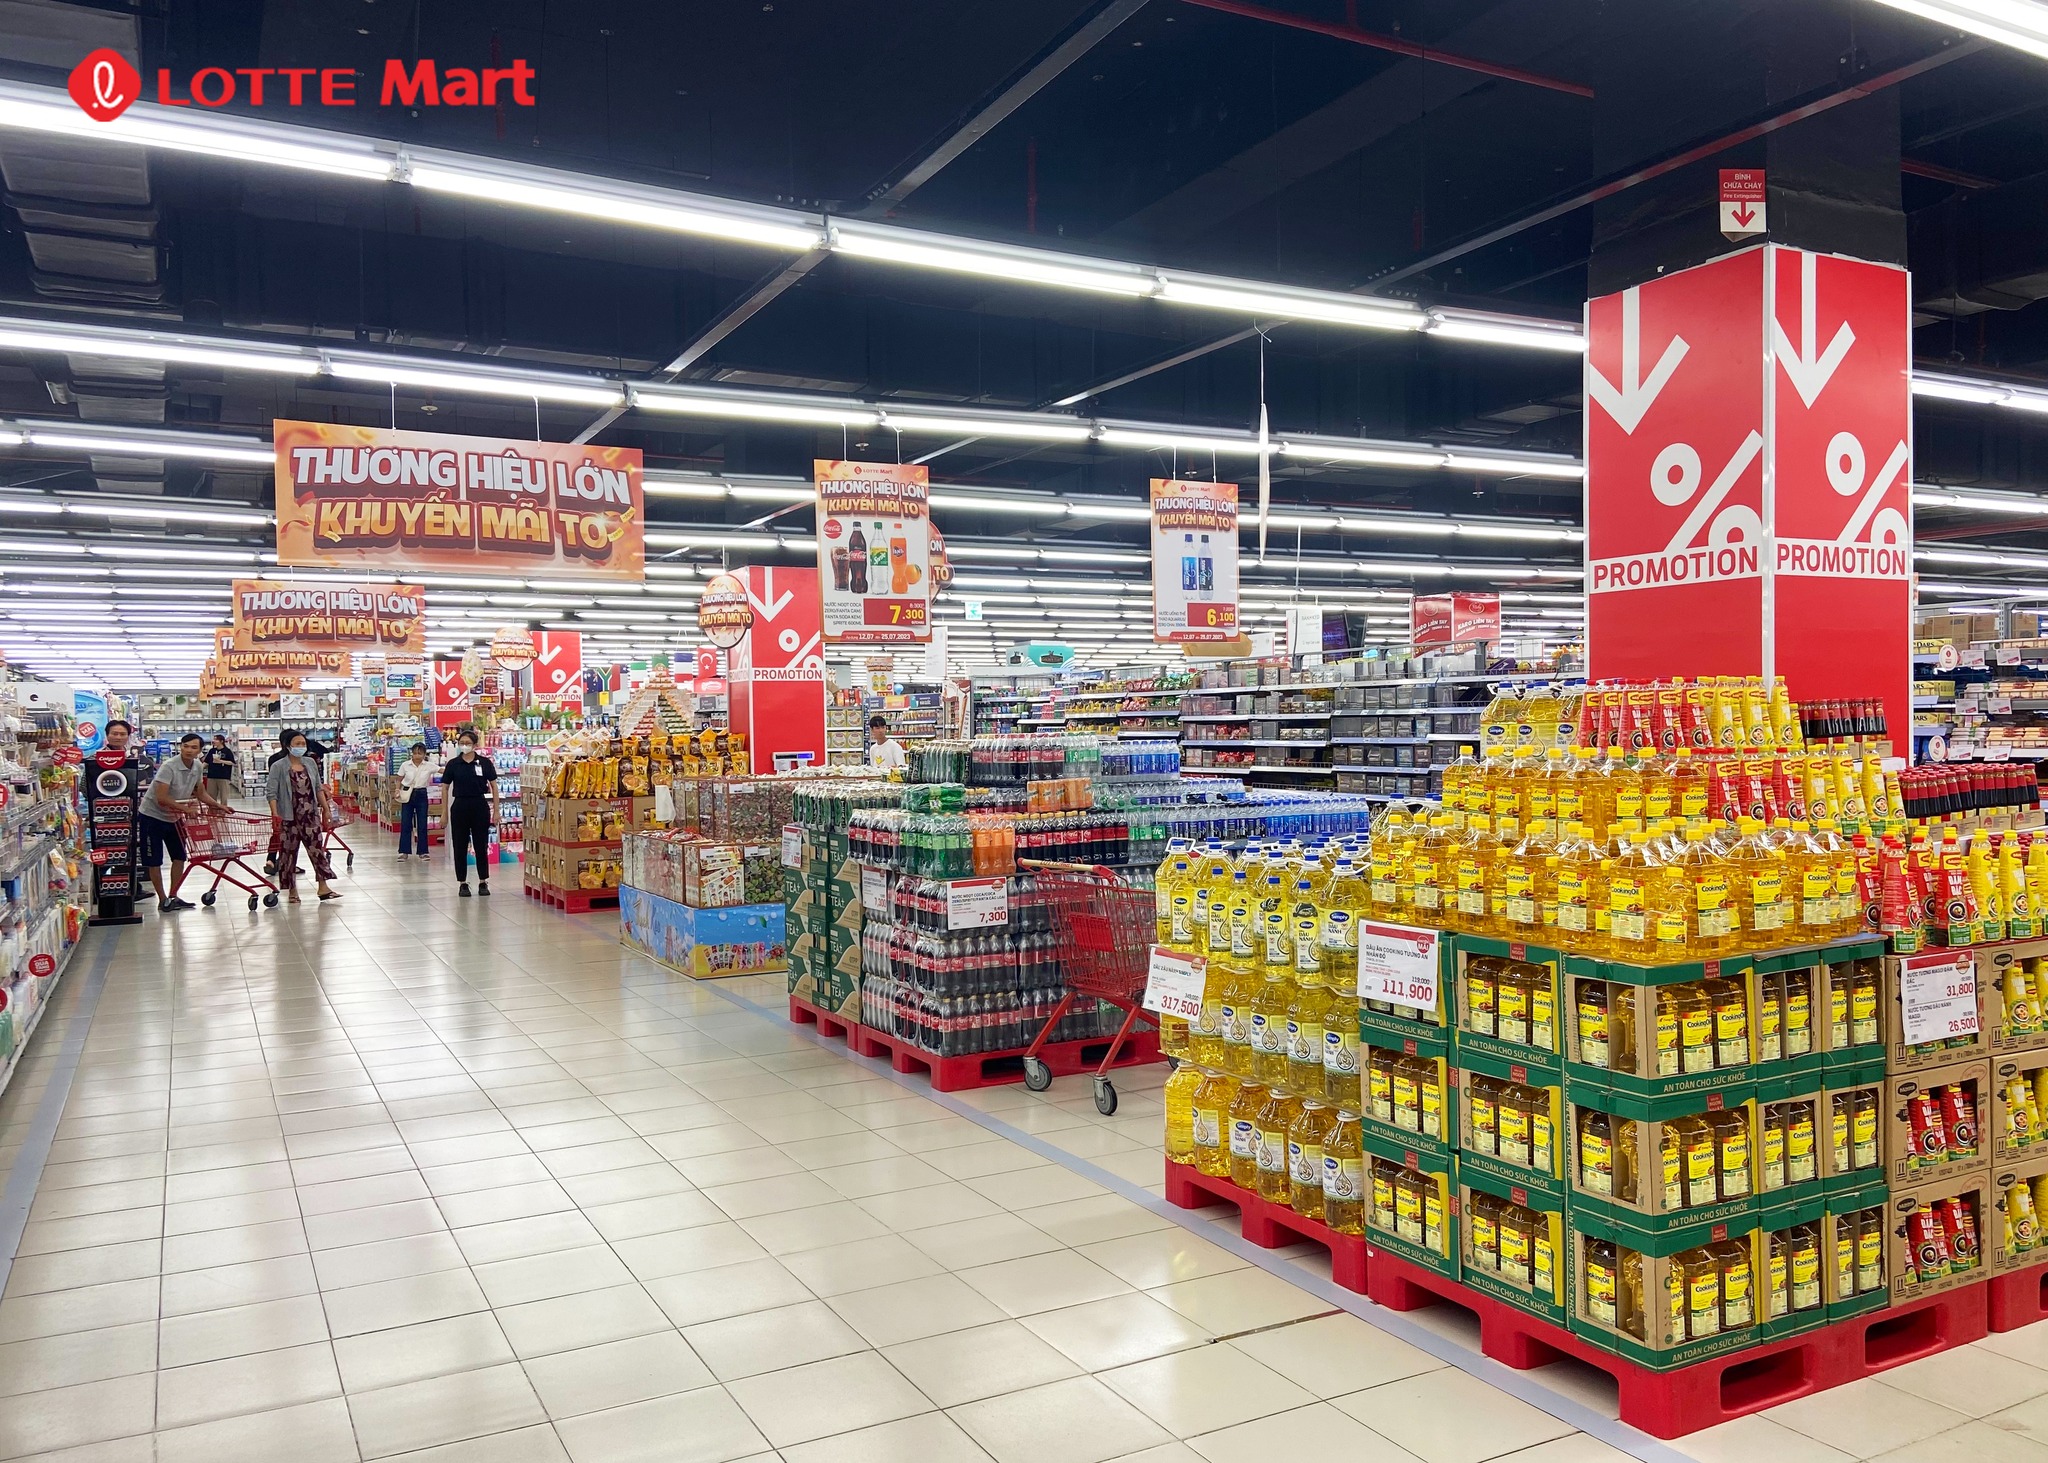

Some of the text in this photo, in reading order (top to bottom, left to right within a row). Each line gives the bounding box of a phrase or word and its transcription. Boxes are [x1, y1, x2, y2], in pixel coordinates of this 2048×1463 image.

[293, 448, 631, 504] THƯƠNG HIỆU LỚN
[821, 479, 925, 498] THƯƠNG HIỆU LỚN
[829, 495, 918, 514] KHUYẾN MÃI TO
[1155, 497, 1235, 513] THƯƠNG HIỆU LỚN
[319, 492, 607, 548] KHUYẾN MÃI TO
[1161, 510, 1229, 527] KHUYẾN TO
[1593, 545, 1758, 590] PROMOTION
[1777, 543, 1906, 576] PROMOTION
[935, 566, 948, 581] TO
[242, 590, 418, 615] THƯƠNG HIỆU LỚN
[255, 611, 405, 637] KHUYẾN MÃI TO
[742, 614, 751, 623] TO
[320, 654, 338, 666] TO
[754, 669, 822, 679] PROMOTION
[830, 851, 844, 862] TEA+
[786, 881, 800, 892] TEA+
[1611, 885, 1639, 896] CookingOil
[831, 895, 845, 908] TEA+
[980, 911, 1006, 923] 7,300
[786, 923, 799, 936] TEA+
[1383, 947, 1403, 955] COOKING
[1383, 979, 1432, 1001] 111,900
[1946, 983, 1973, 997] 31,800
[1161, 996, 1199, 1016] 317,500
[1376, 1018, 1391, 1028] TOÀN
[1392, 1023, 1403, 1031] CHO
[1949, 1017, 1975, 1032] 26,500
[1469, 1039, 1547, 1064] AN TOÀN CHO SỨC KHỎE
[1664, 1072, 1746, 1092] AN TOÀN CHO SỨC KHỎE
[1395, 1134, 1407, 1142] CHO
[1471, 1158, 1479, 1166] AN
[1481, 1160, 1498, 1172] TOÀN
[1500, 1167, 1513, 1177] CHO
[1669, 1203, 1748, 1227] AN TOÀN CHO SỨC KHỎE
[1472, 1276, 1480, 1285] AN
[1482, 1279, 1499, 1292] TOÀN
[1500, 1287, 1514, 1298] CHO
[1672, 1354, 1682, 1362] AN
[1684, 1347, 1702, 1358] TOÀN
[1704, 1344, 1717, 1353] CHO
